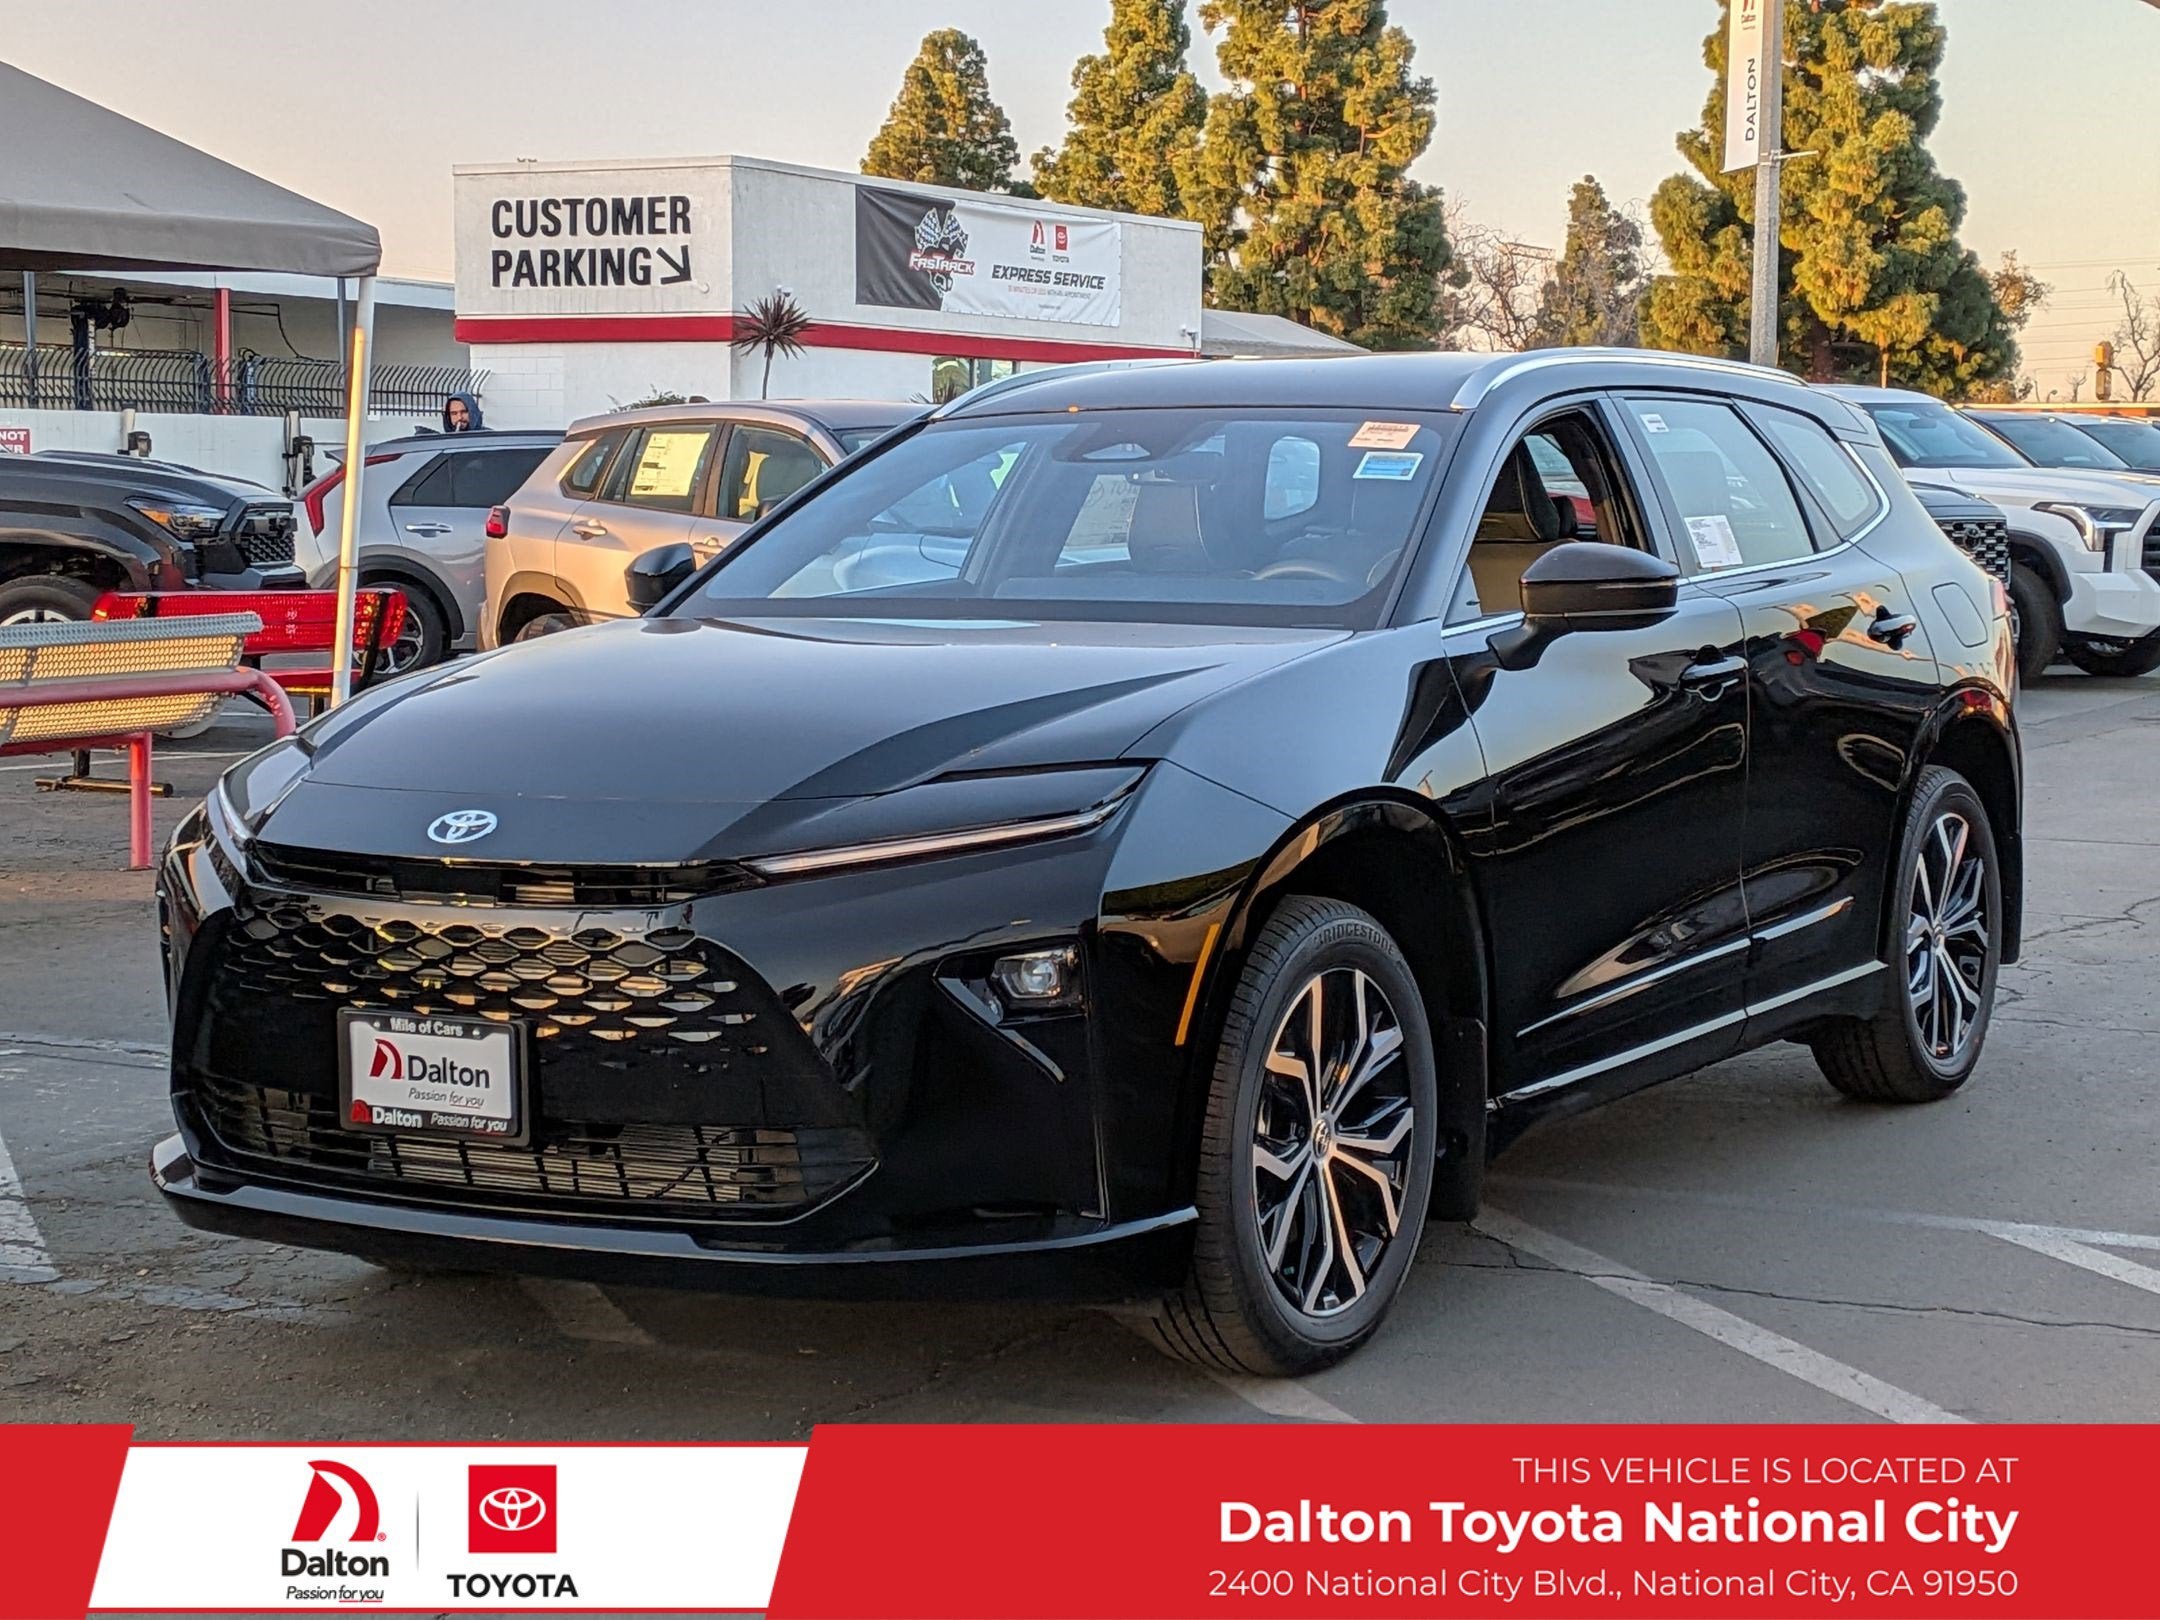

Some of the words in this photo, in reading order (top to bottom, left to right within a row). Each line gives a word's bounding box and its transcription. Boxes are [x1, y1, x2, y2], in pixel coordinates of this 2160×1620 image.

[1745, 58, 1757, 141] DALTON
[491, 195, 692, 239] CUSTOMER
[491, 246, 652, 288] PARKING
[991, 264, 1052, 285] EXPRESS
[1052, 271, 1106, 291] SERVICE
[390, 1016, 417, 1033] Mile
[419, 1020, 433, 1034] of
[433, 1021, 464, 1037] Cars
[407, 1054, 491, 1089] Dalton
[408, 1087, 447, 1102] Passion
[449, 1090, 464, 1105] for
[464, 1096, 485, 1108] you
[371, 1106, 423, 1129] Dalton
[430, 1112, 470, 1129] Passion
[470, 1115, 486, 1130] for
[486, 1120, 508, 1133] you
